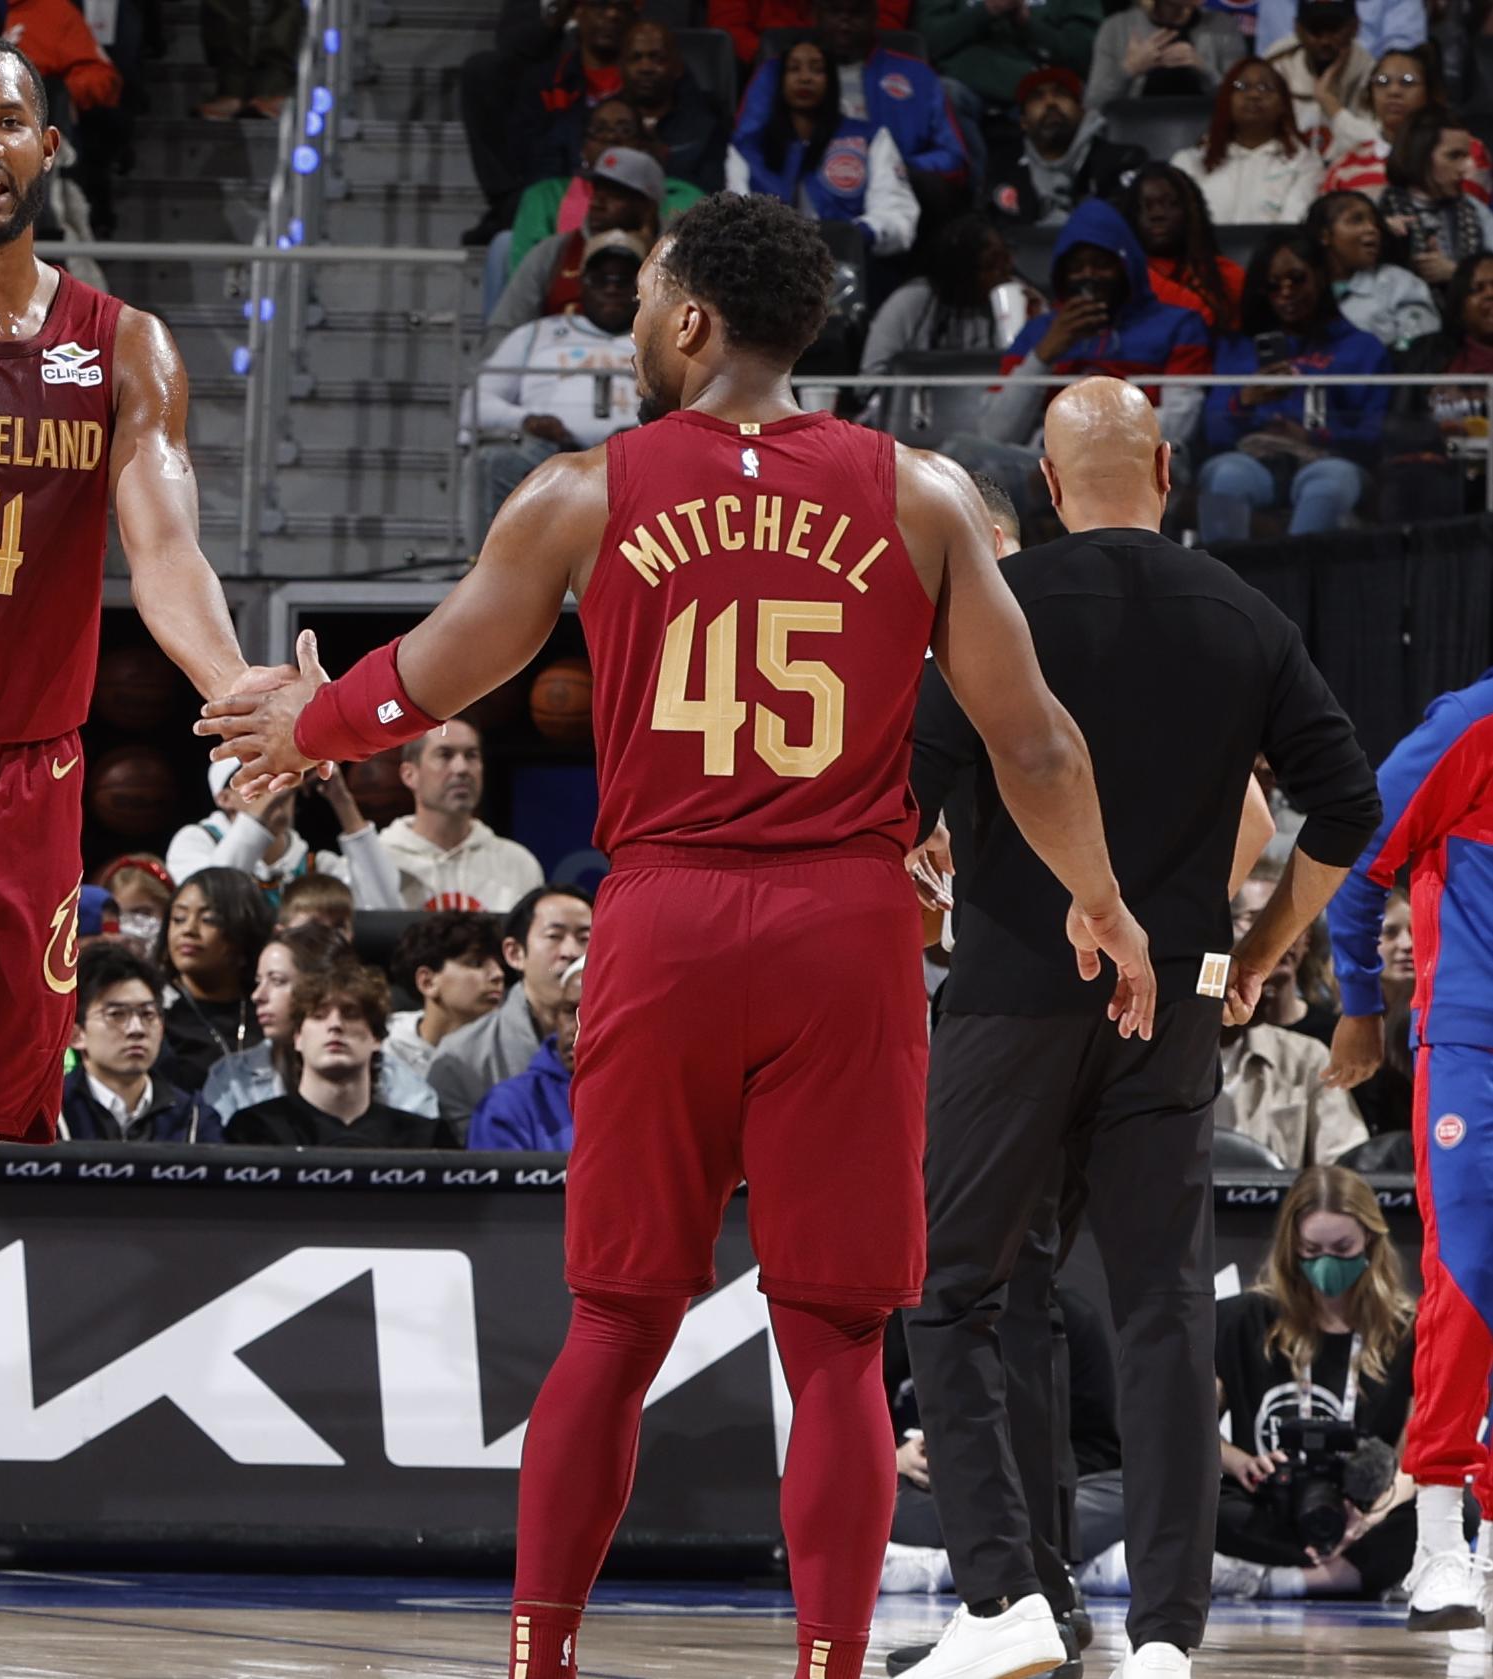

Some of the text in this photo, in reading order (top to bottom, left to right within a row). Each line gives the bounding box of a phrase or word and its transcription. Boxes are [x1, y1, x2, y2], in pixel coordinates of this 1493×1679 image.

[43, 368, 100, 382] CLIFFS
[618, 495, 889, 594] MITCHELL
[650, 598, 845, 778] 45
[6, 1161, 62, 1176] KIA
[79, 1163, 135, 1177] KIA
[151, 1165, 208, 1179] KIA
[224, 1166, 281, 1181] KIA
[297, 1168, 353, 1182] KIA
[370, 1169, 426, 1183] KIA
[443, 1168, 499, 1184] KIA
[515, 1168, 568, 1184] KIA
[1226, 1188, 1278, 1202] KIA
